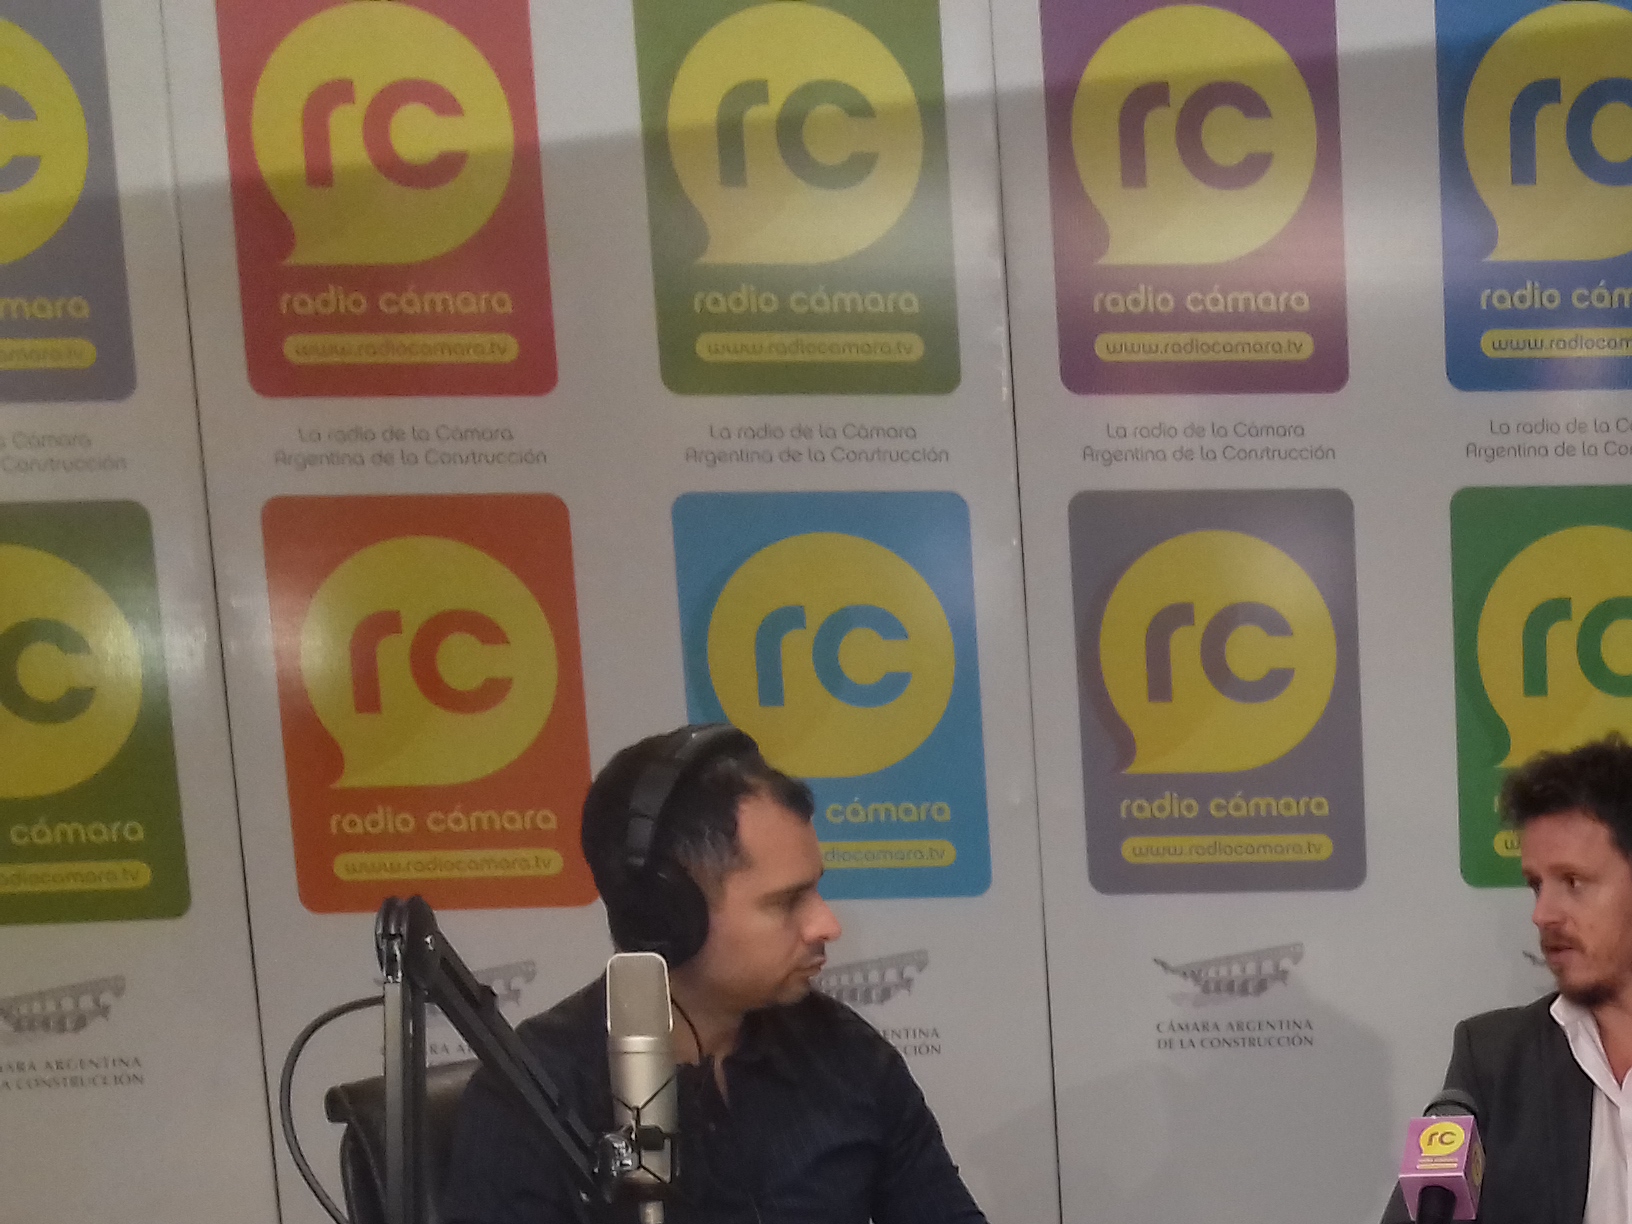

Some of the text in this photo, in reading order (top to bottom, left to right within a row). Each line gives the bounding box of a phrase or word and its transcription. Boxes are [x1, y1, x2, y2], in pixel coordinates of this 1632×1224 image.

[302, 77, 469, 190] rc
[715, 79, 879, 190] rc
[1119, 80, 1274, 190] rc
[0, 297, 90, 319] mara
[280, 284, 513, 315] radio cámara
[694, 283, 919, 314] radio cámara
[1094, 283, 1310, 314] radio cámara
[1480, 280, 1561, 310] radio
[1106, 339, 1303, 356] www.radiocamara.tv
[1107, 422, 1127, 439] La
[1134, 421, 1177, 439] radio
[1184, 421, 1206, 439] de
[1212, 421, 1228, 438] la
[1490, 419, 1510, 435] La
[1516, 418, 1560, 435] radio
[1566, 417, 1588, 434] de
[1594, 417, 1610, 434] la
[1083, 445, 1167, 467] Argentina
[1173, 444, 1195, 461] de
[1200, 444, 1217, 461] la
[1466, 441, 1548, 463] Argentina
[1554, 440, 1576, 457] de
[1582, 440, 1598, 457] la
[350, 609, 514, 714] rc
[755, 604, 912, 708] rc
[1145, 601, 1295, 703] rc
[0, 618, 96, 724] c
[330, 804, 557, 834] radio cámara
[826, 797, 951, 823] cámara
[1120, 791, 1329, 819] radio cámara
[10, 817, 145, 845] cámara
[882, 1027, 940, 1039] ENTINA
[1226, 1017, 1314, 1032] ARGENTINA
[1157, 1037, 1173, 1050] DE
[1179, 1036, 1196, 1050] LA
[1427, 1131, 1456, 1146] rc
